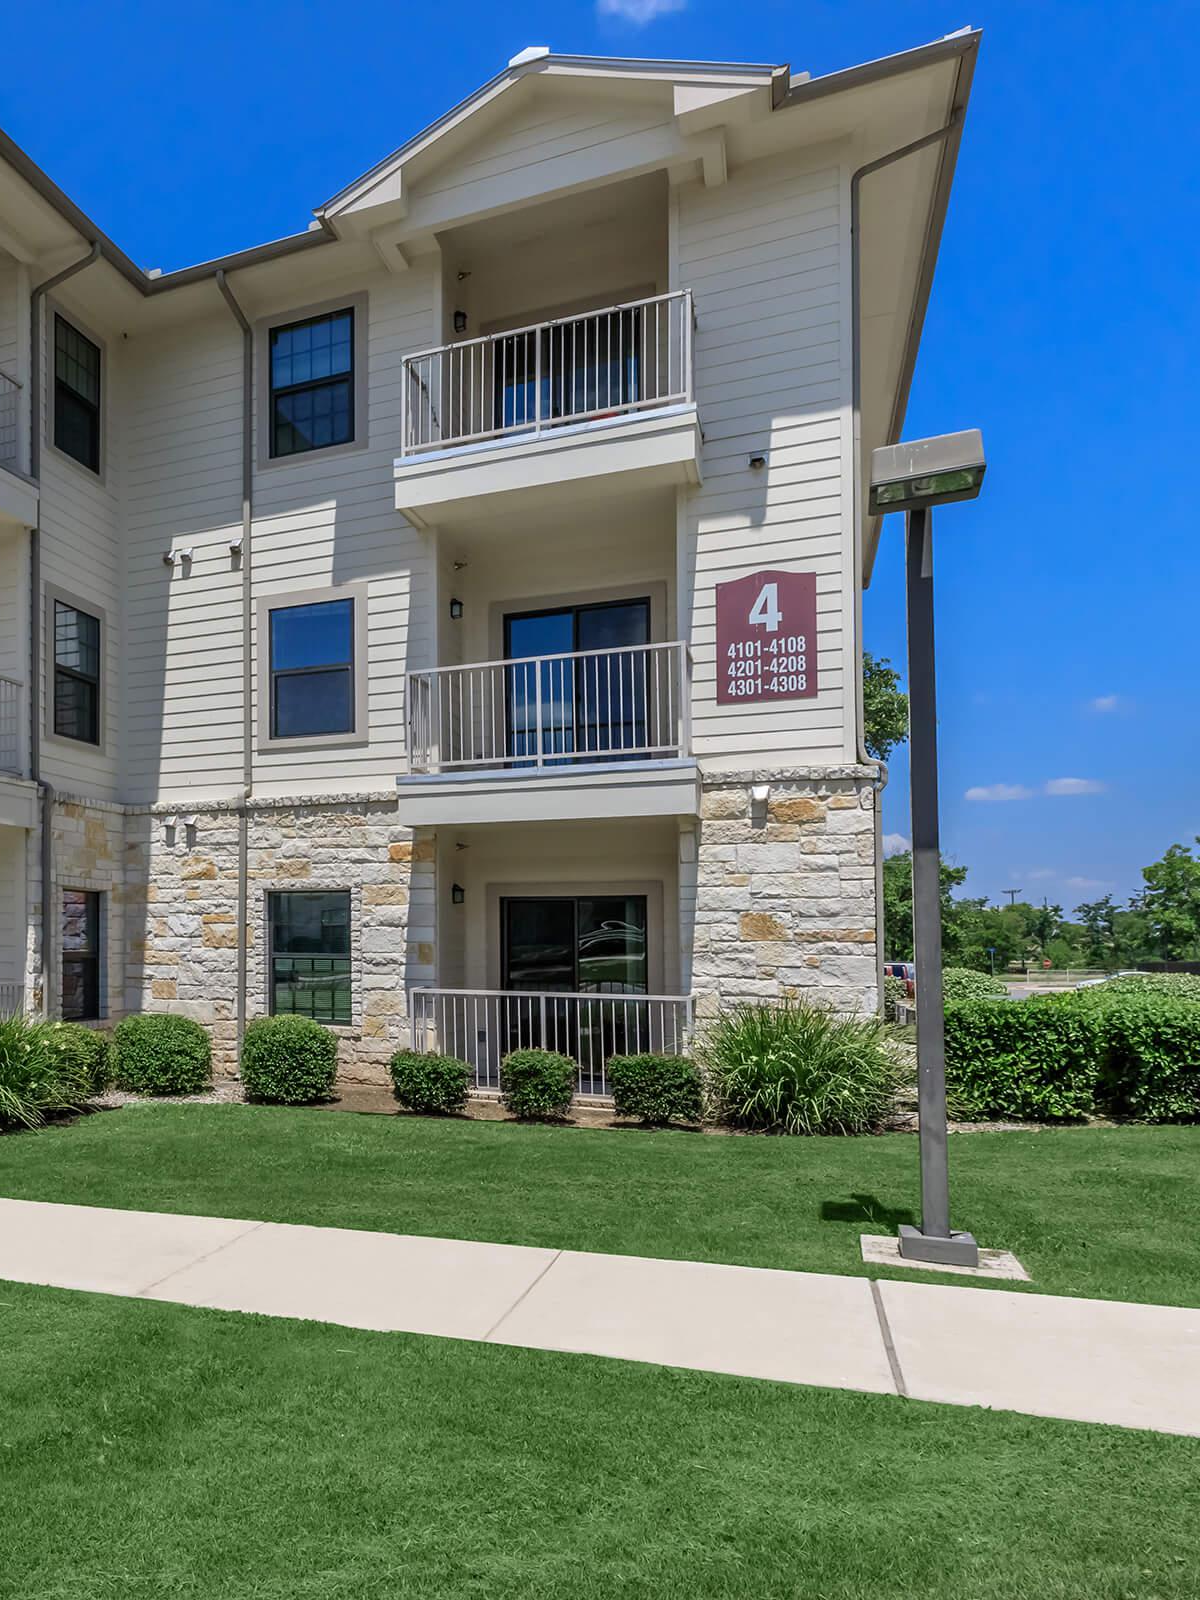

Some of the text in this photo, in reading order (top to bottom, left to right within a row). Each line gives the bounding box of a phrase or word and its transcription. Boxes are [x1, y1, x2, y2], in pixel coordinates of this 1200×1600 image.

[749, 583, 782, 632] 4
[728, 636, 806, 659] 4101-4108
[728, 655, 806, 677] 4201-4208
[728, 674, 806, 696] 4301-4308
